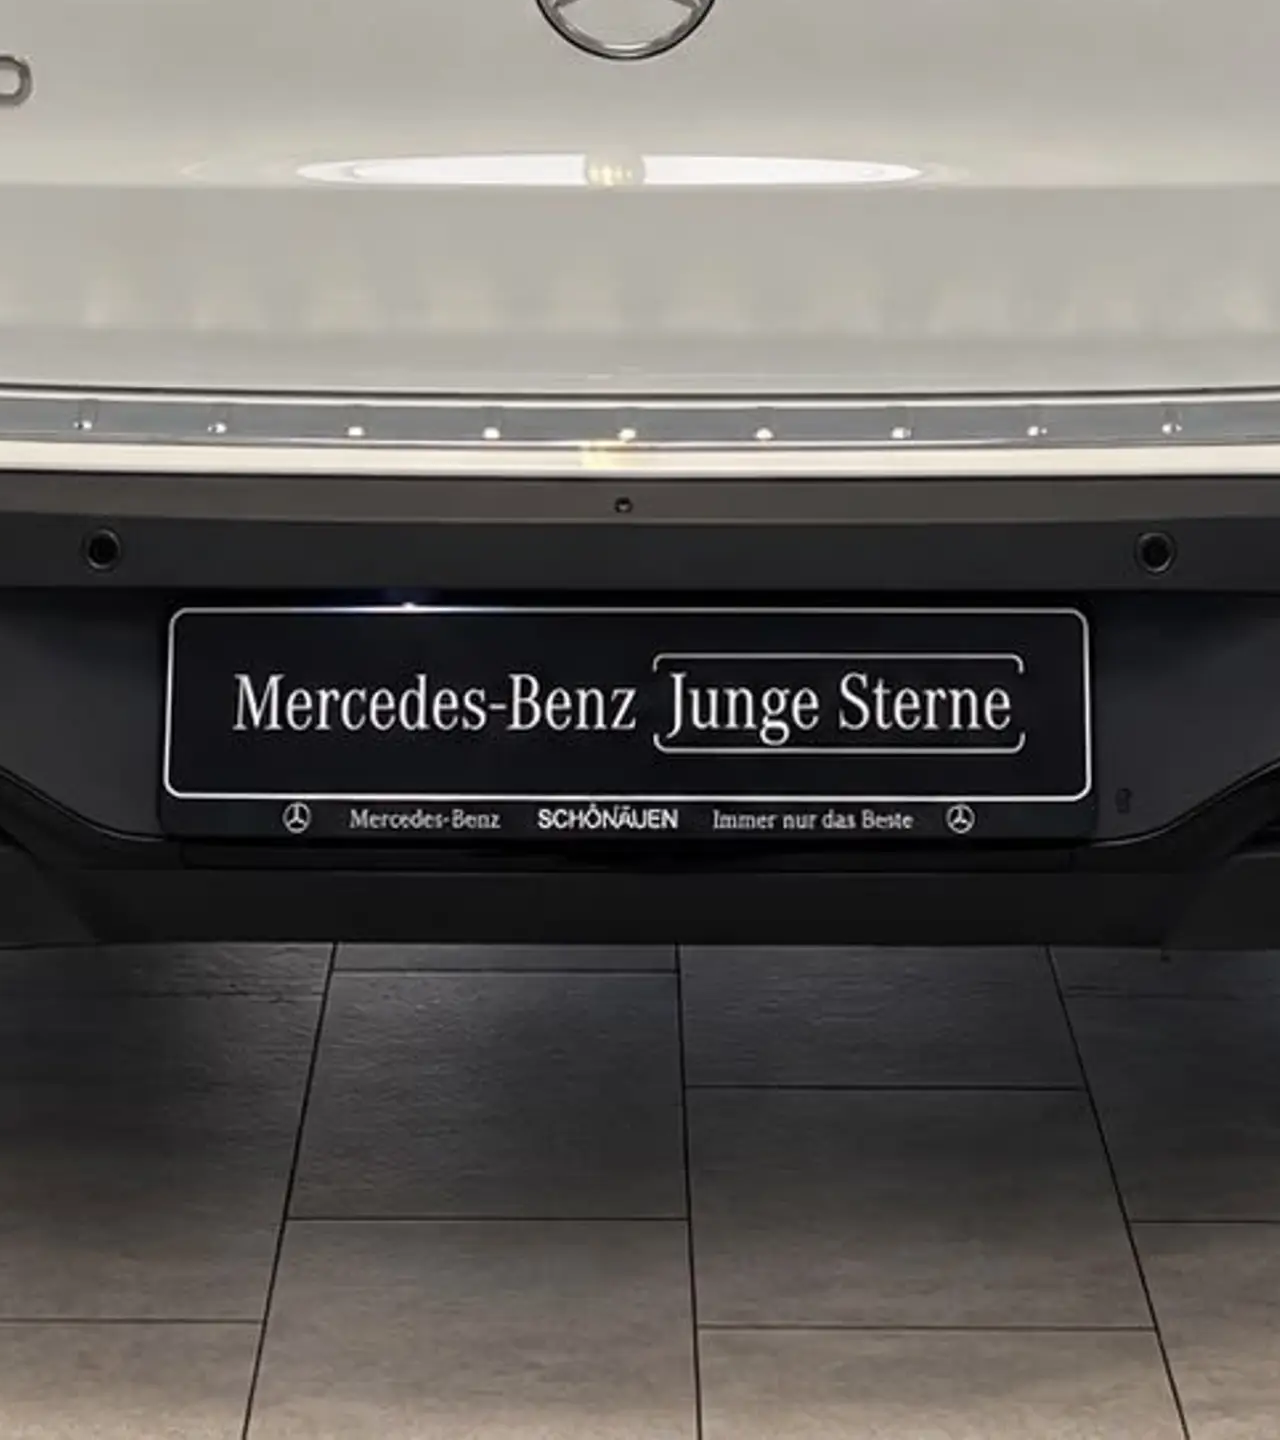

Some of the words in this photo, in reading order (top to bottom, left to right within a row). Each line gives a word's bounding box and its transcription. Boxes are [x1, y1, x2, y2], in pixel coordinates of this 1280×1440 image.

[231, 672, 638, 732] Mercedes-Benz
[665, 671, 820, 747] Junge
[837, 671, 1013, 732] Sterne
[349, 808, 502, 830] Mercedes-Benz
[712, 809, 779, 830] Immer
[783, 813, 819, 830] nur
